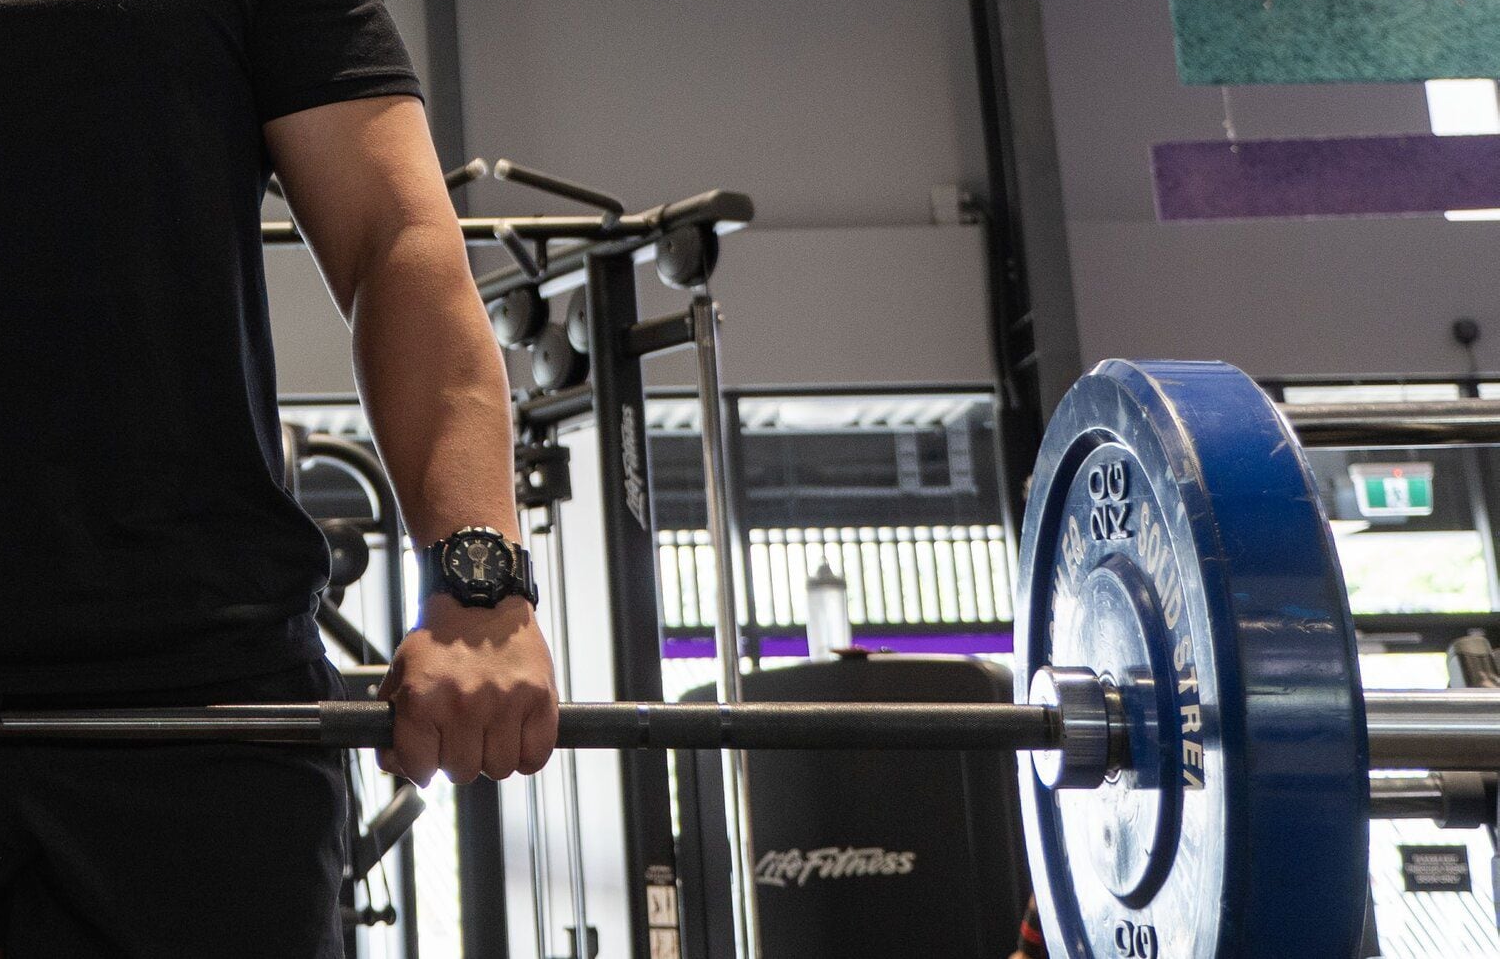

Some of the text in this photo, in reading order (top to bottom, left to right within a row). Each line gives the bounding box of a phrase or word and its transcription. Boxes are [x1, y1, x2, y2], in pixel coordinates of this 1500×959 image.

[1088, 463, 1109, 540] 20
[1107, 459, 1135, 541] KG
[1136, 501, 1182, 630] SOLID
